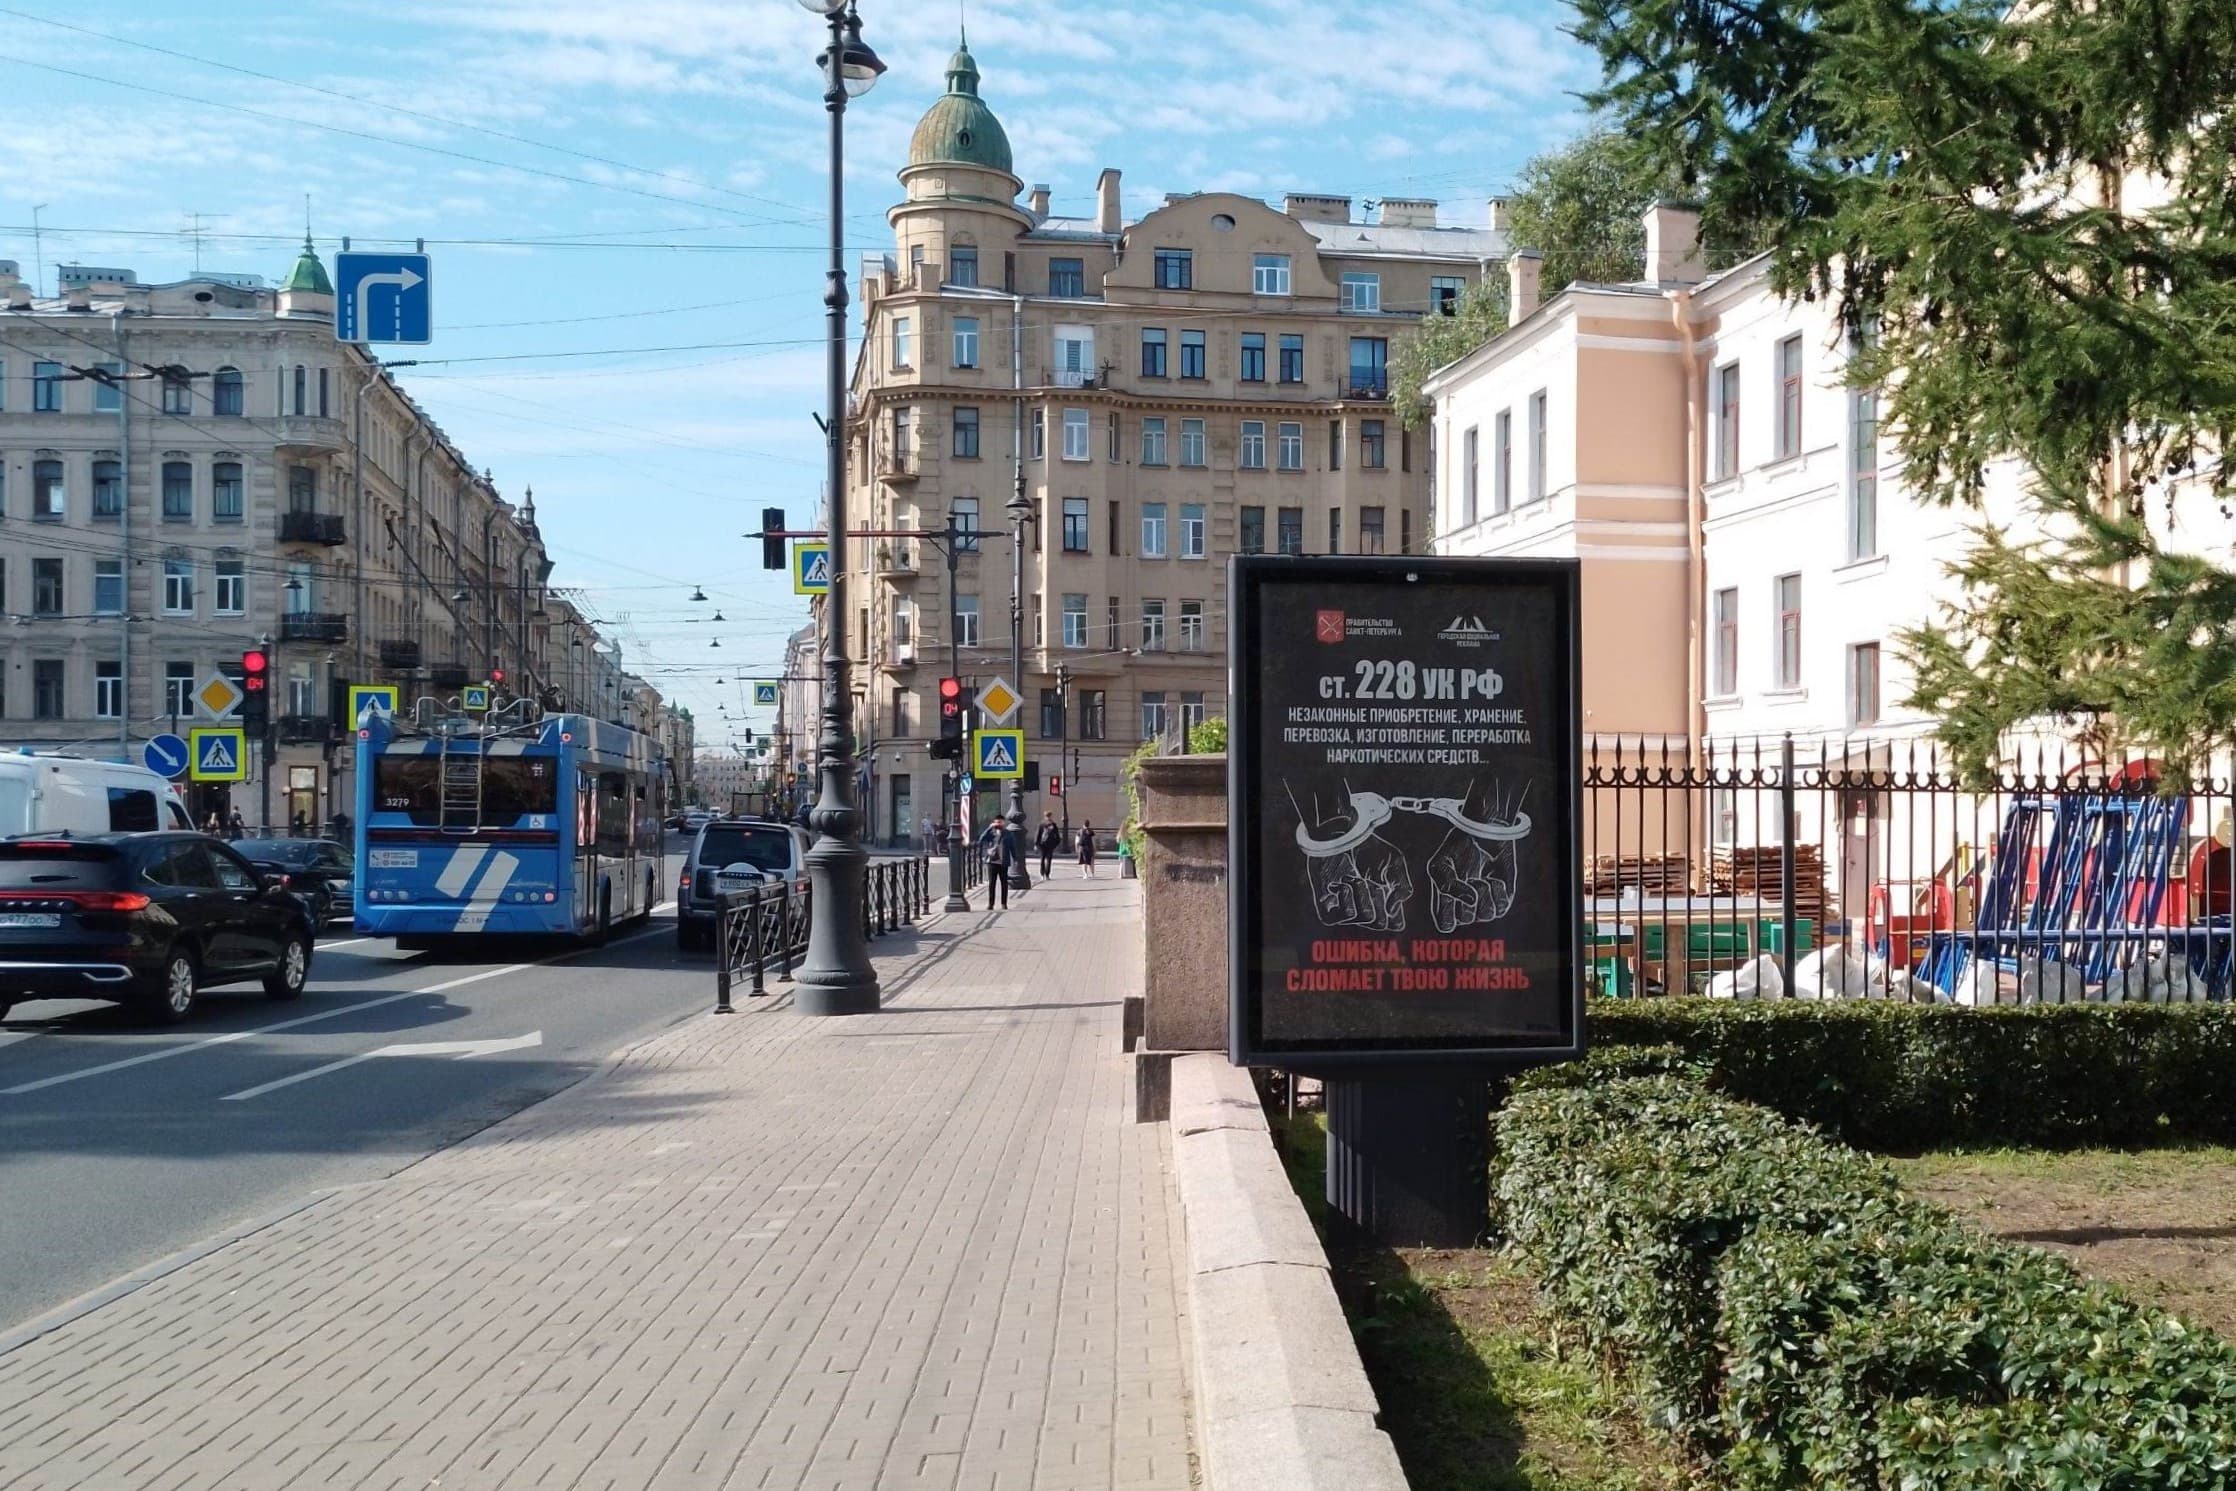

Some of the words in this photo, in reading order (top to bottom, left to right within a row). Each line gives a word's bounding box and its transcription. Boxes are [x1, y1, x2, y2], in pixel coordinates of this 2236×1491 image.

[1354, 659, 1416, 700] 228
[1422, 668, 1455, 700] УК
[1460, 668, 1504, 700] РФ
[1288, 706, 1367, 723] НЕЗАКОННЫЕ
[1369, 707, 1462, 725] ПРИОБРЕТЕНИЕ,
[1464, 708, 1528, 726] ХРАНЕНИЕ,
[1283, 727, 1354, 745] ПЕРЕВОЗКА,
[1356, 727, 1450, 745] ИЗГОТОВЛЕНИЕ,
[1452, 728, 1531, 745] ПЕРЕРАБОТКА
[1326, 748, 1425, 764] НАРКОТИЧЕСКИХ
[1427, 748, 1490, 765] СРЕДСТВ...
[385, 798, 410, 808] 3279
[1312, 940, 1406, 964] ОШИБКА,
[1412, 940, 1505, 961] КОТОРАЯ
[1286, 968, 1386, 992] СЛОМАЕТ
[1391, 968, 1449, 990] ТВОЮ
[1454, 967, 1530, 990] ЖИЗНЬ
